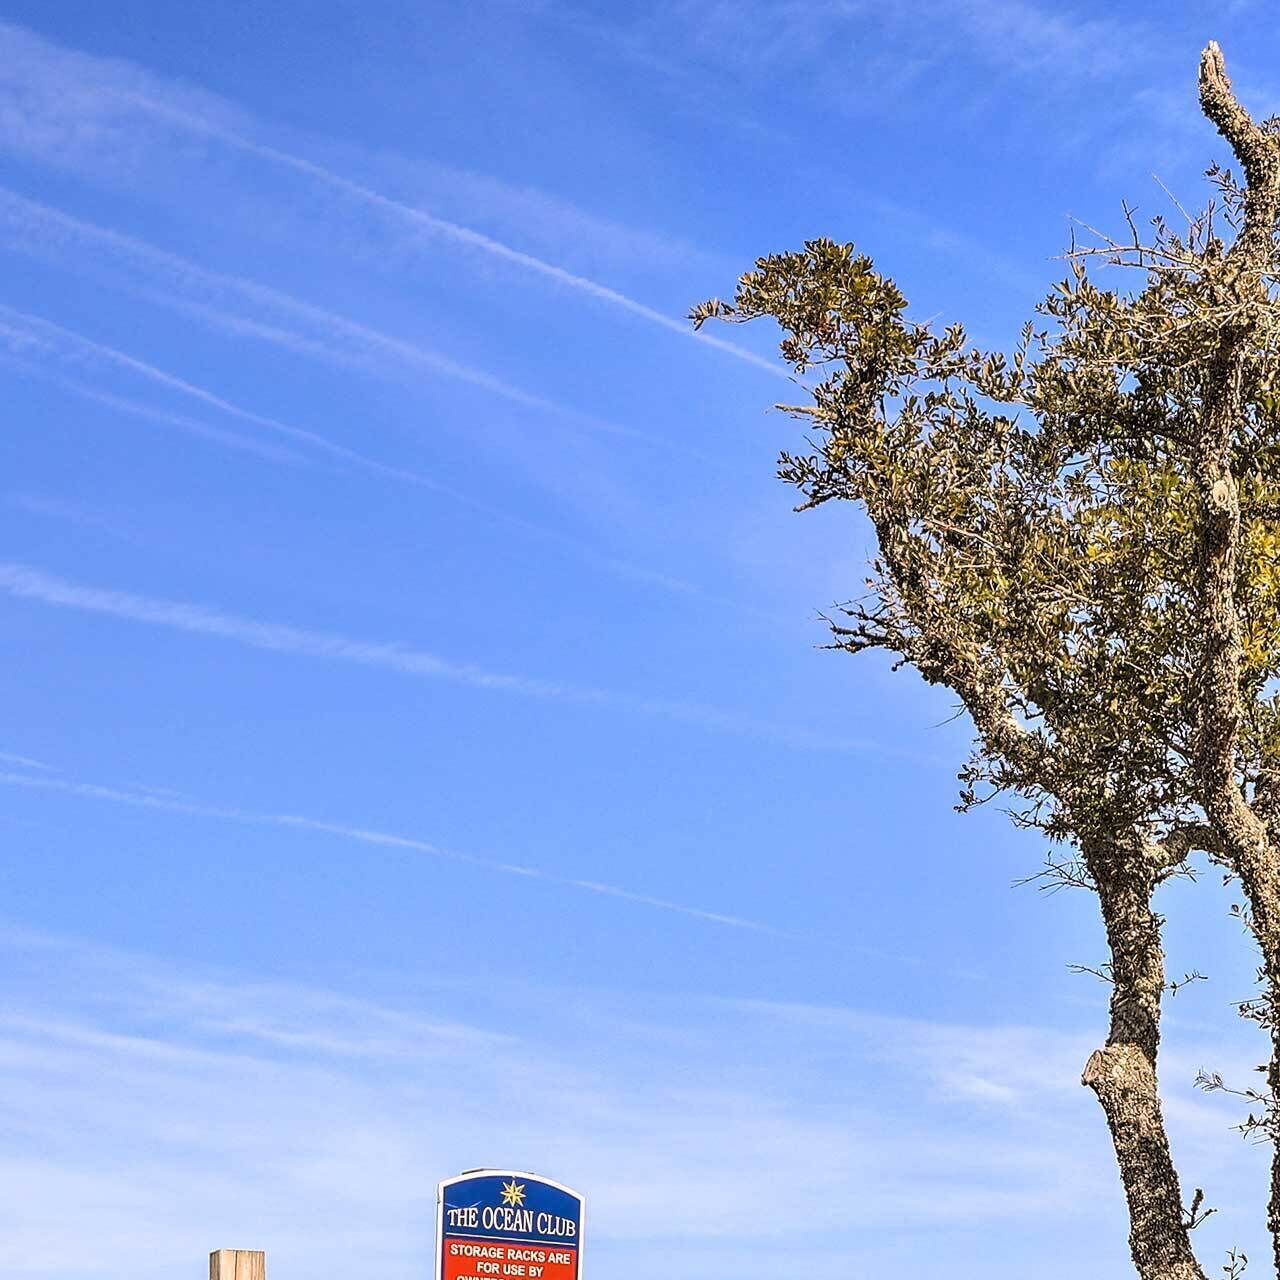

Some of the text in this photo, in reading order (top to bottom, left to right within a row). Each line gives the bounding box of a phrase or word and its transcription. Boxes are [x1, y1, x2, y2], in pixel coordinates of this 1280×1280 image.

[447, 1206, 576, 1237] THE OCEAN CLUB
[450, 1243, 571, 1264] STORAGE RACKS ARE
[477, 1262, 543, 1278] FOR USE BY
